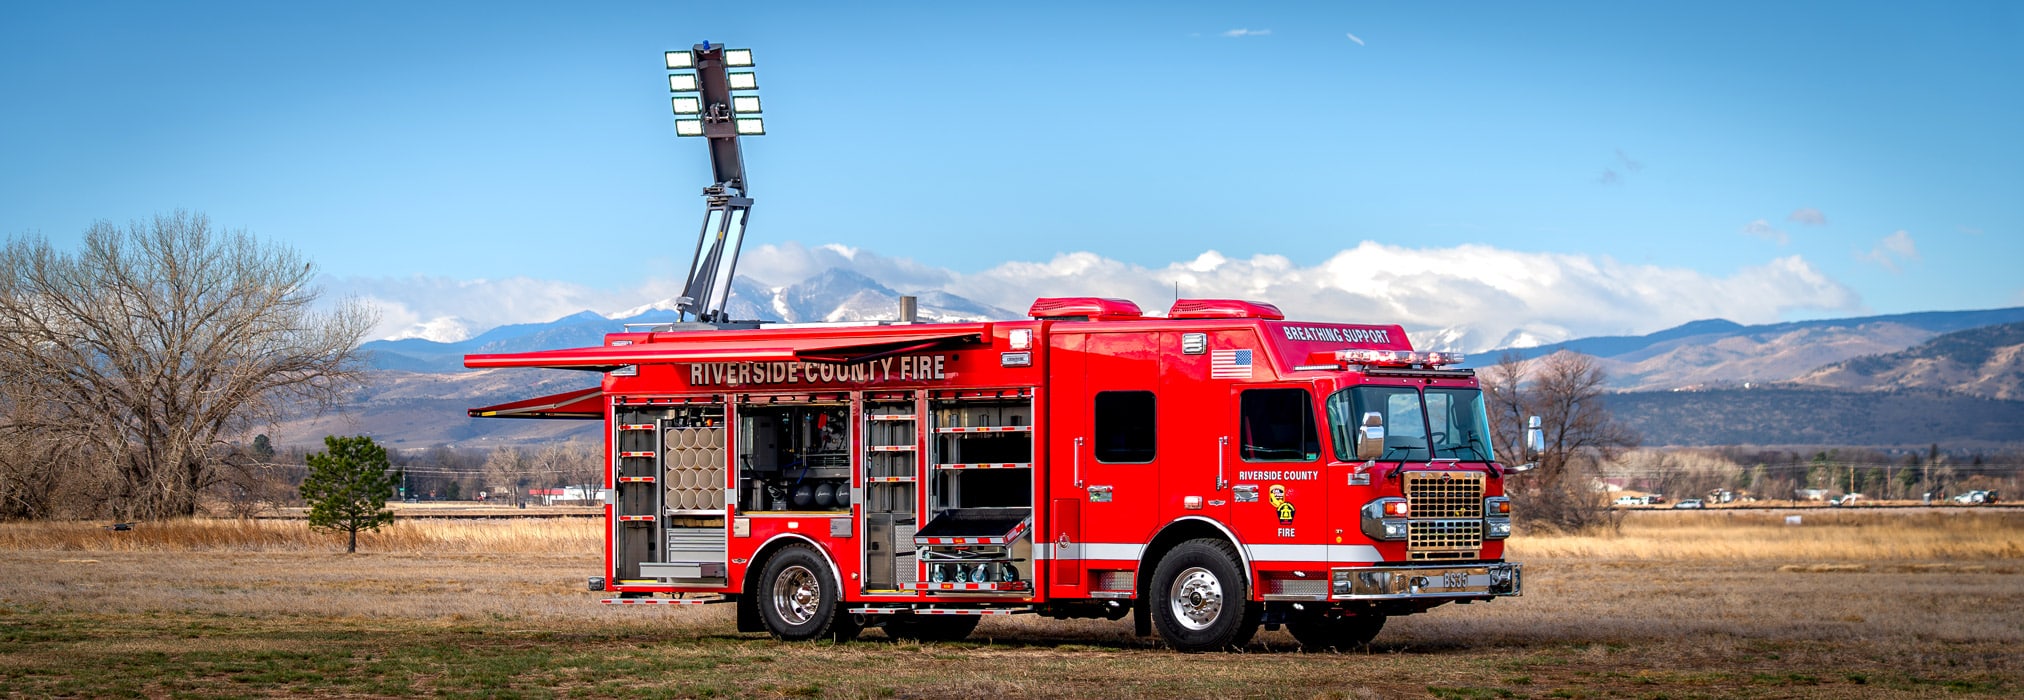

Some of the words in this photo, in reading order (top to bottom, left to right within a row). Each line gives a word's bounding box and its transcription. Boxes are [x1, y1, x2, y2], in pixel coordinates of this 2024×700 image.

[1282, 326, 1343, 342] BREATHING
[1342, 328, 1390, 344] SUPPORT
[690, 361, 799, 385] RIVERSIDE
[804, 357, 893, 382] COUNTY
[900, 355, 945, 380] FIRE
[1239, 470, 1282, 481] RIVERSIDE
[1283, 470, 1319, 481] COUNTY
[1277, 527, 1296, 538] FIRE
[1444, 572, 1468, 588] BS35
